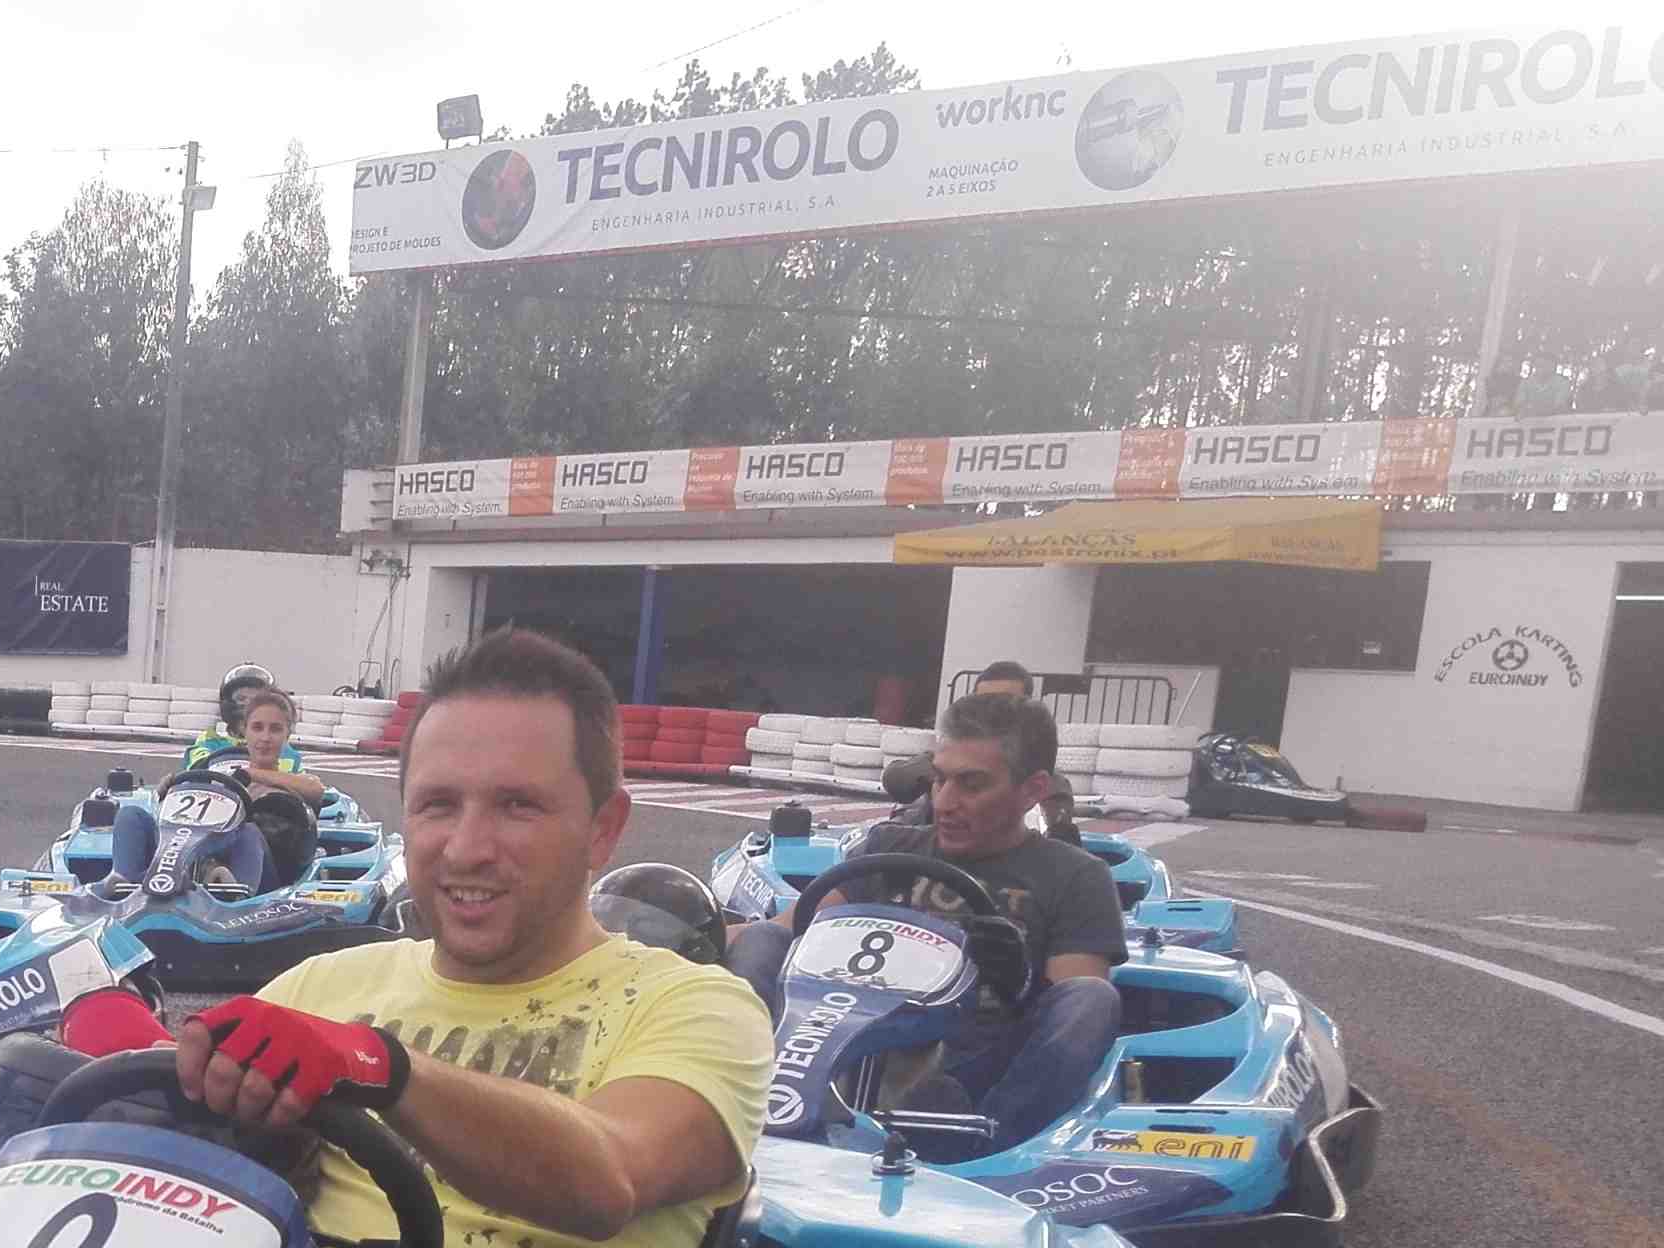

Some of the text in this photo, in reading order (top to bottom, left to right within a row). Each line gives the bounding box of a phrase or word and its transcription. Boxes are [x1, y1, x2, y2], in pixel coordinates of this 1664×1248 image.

[1215, 26, 1664, 135] TECNIROL
[936, 86, 1066, 128] worknc
[557, 109, 900, 205] TECNIROLO
[928, 158, 1019, 180] MAQUINAÇÃO
[354, 161, 437, 189] ZW3D
[926, 179, 997, 198] 2 A 5 EIXOS
[591, 208, 690, 232] ENGENHARIA
[389, 239, 403, 251] DE
[404, 236, 441, 249] MOLDES
[1193, 434, 1321, 465] HASCO
[1466, 425, 1613, 459] HASCO
[746, 452, 845, 479] HASCO
[956, 443, 1068, 472] HASCO
[399, 469, 475, 495] HASCO
[562, 460, 648, 487] HASCO
[607, 494, 632, 507] with
[743, 490, 794, 503] Enabling
[799, 488, 824, 501] with
[39, 582, 63, 592] REAL
[40, 594, 109, 613] ESTATE
[1434, 625, 1583, 688] ESCOLA KARTING
[1468, 671, 1549, 687] EUROINDY
[171, 795, 213, 822] 21
[830, 919, 947, 947] EUROINDY
[847, 930, 895, 977] 8
[1153, 1136, 1244, 1159] eni
[1011, 1165, 1139, 1208] OSOC
